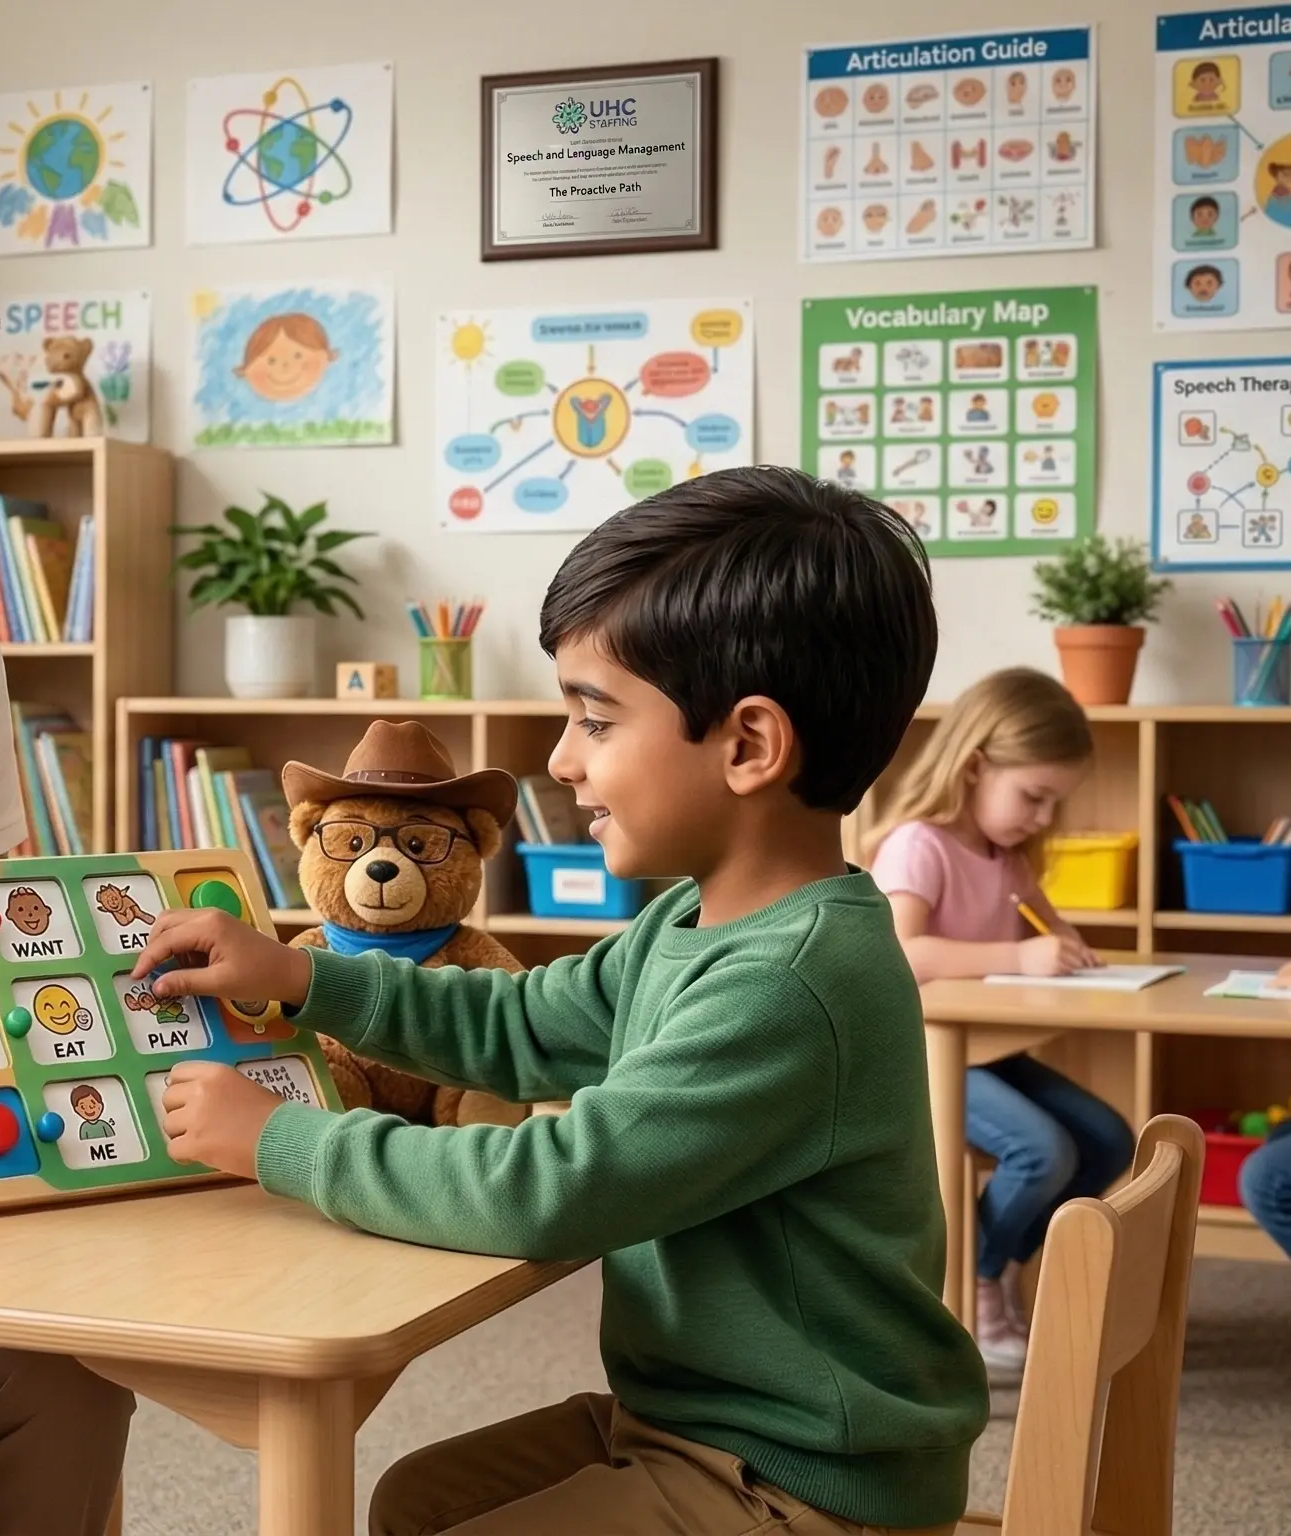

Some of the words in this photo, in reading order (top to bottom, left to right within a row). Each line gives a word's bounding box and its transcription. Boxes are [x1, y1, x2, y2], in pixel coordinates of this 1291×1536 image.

[846, 43, 976, 72] Articulation
[981, 37, 1048, 60] Guide
[590, 98, 636, 117] UHC
[507, 149, 543, 165] Speech
[546, 148, 564, 160] and
[549, 187, 568, 197] The
[619, 181, 642, 192] Path
[6, 301, 122, 335] SPEECH
[845, 303, 986, 331] Vocabulary
[993, 300, 1049, 327] Map
[1173, 376, 1236, 398] Speech
[1240, 376, 1291, 395] Thera
[348, 670, 365, 690] A
[11, 939, 64, 958] WANT
[119, 932, 149, 949] EAT
[147, 1030, 190, 1049] PLAY
[54, 1041, 86, 1059] EAT
[89, 1143, 118, 1161] ME
